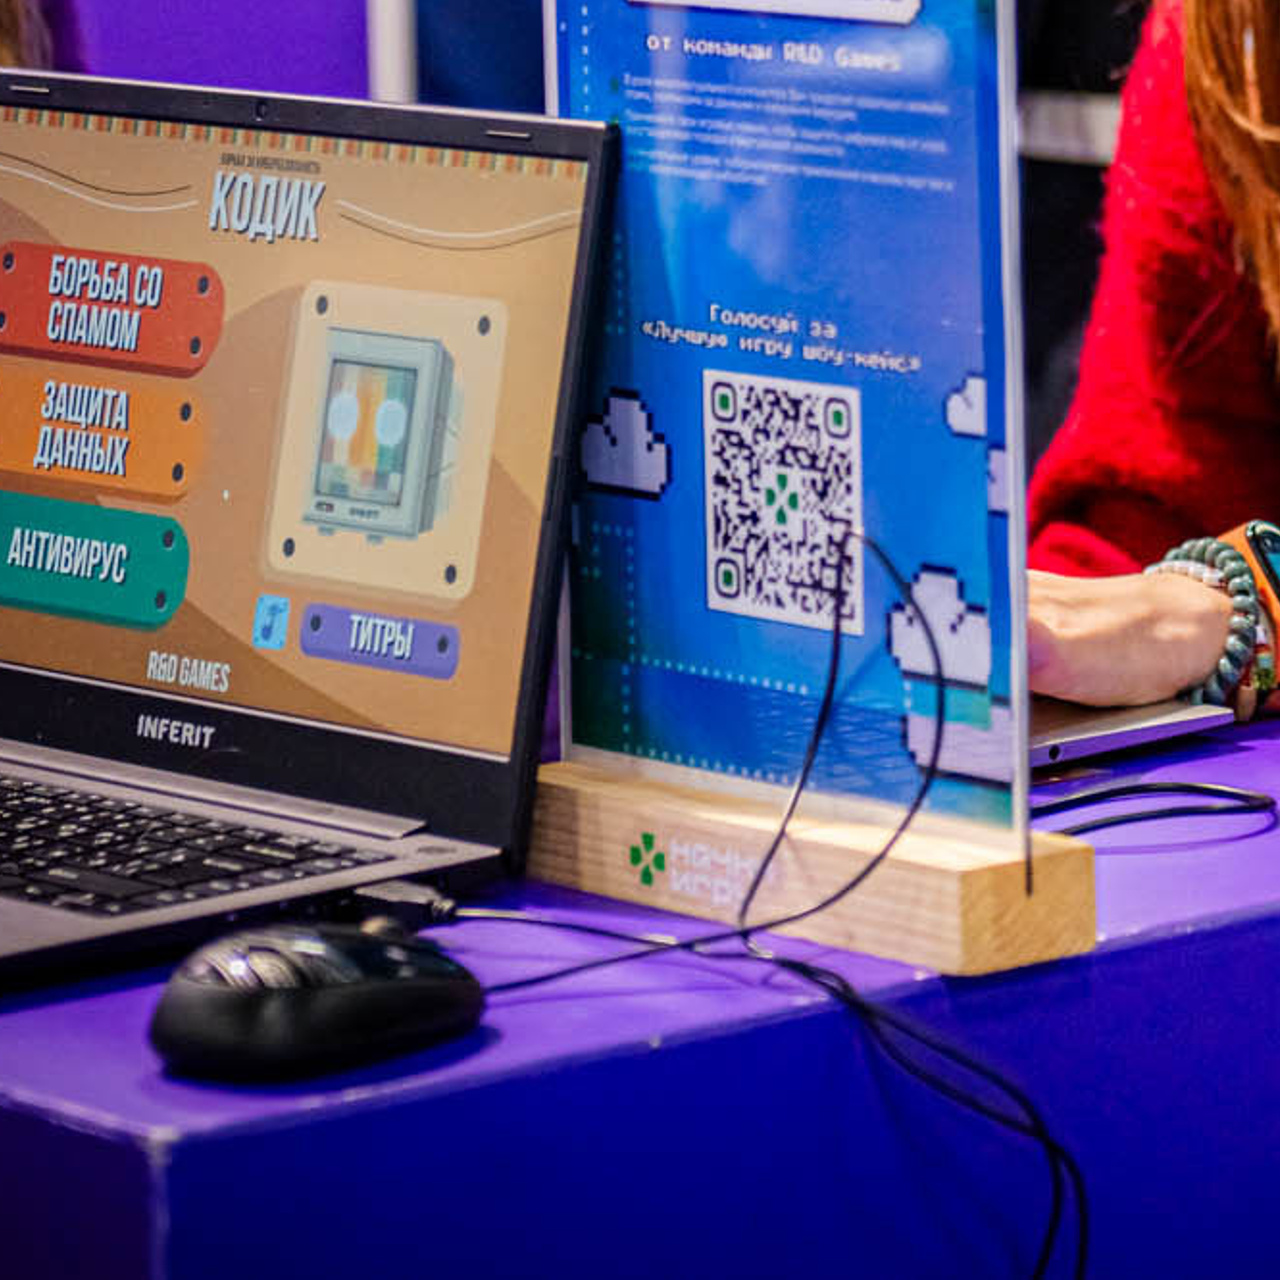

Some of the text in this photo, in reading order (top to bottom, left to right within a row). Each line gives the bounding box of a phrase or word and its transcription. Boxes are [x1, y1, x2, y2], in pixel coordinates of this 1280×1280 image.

[646, 35, 672, 51] от
[209, 170, 327, 244] КОДИК
[48, 254, 164, 309] БОРЬБА СО
[47, 300, 141, 352] СПАМОМ
[710, 304, 838, 339] Голосуй за
[739, 337, 793, 359] игру
[41, 379, 130, 431] ЗАЩИТА
[33, 426, 130, 476] ДАННЫХ
[7, 527, 129, 584] АНТИВИРУС
[350, 614, 415, 660] ТИТРЫ
[179, 656, 231, 693] GAMES
[137, 714, 216, 749] INFERIT
